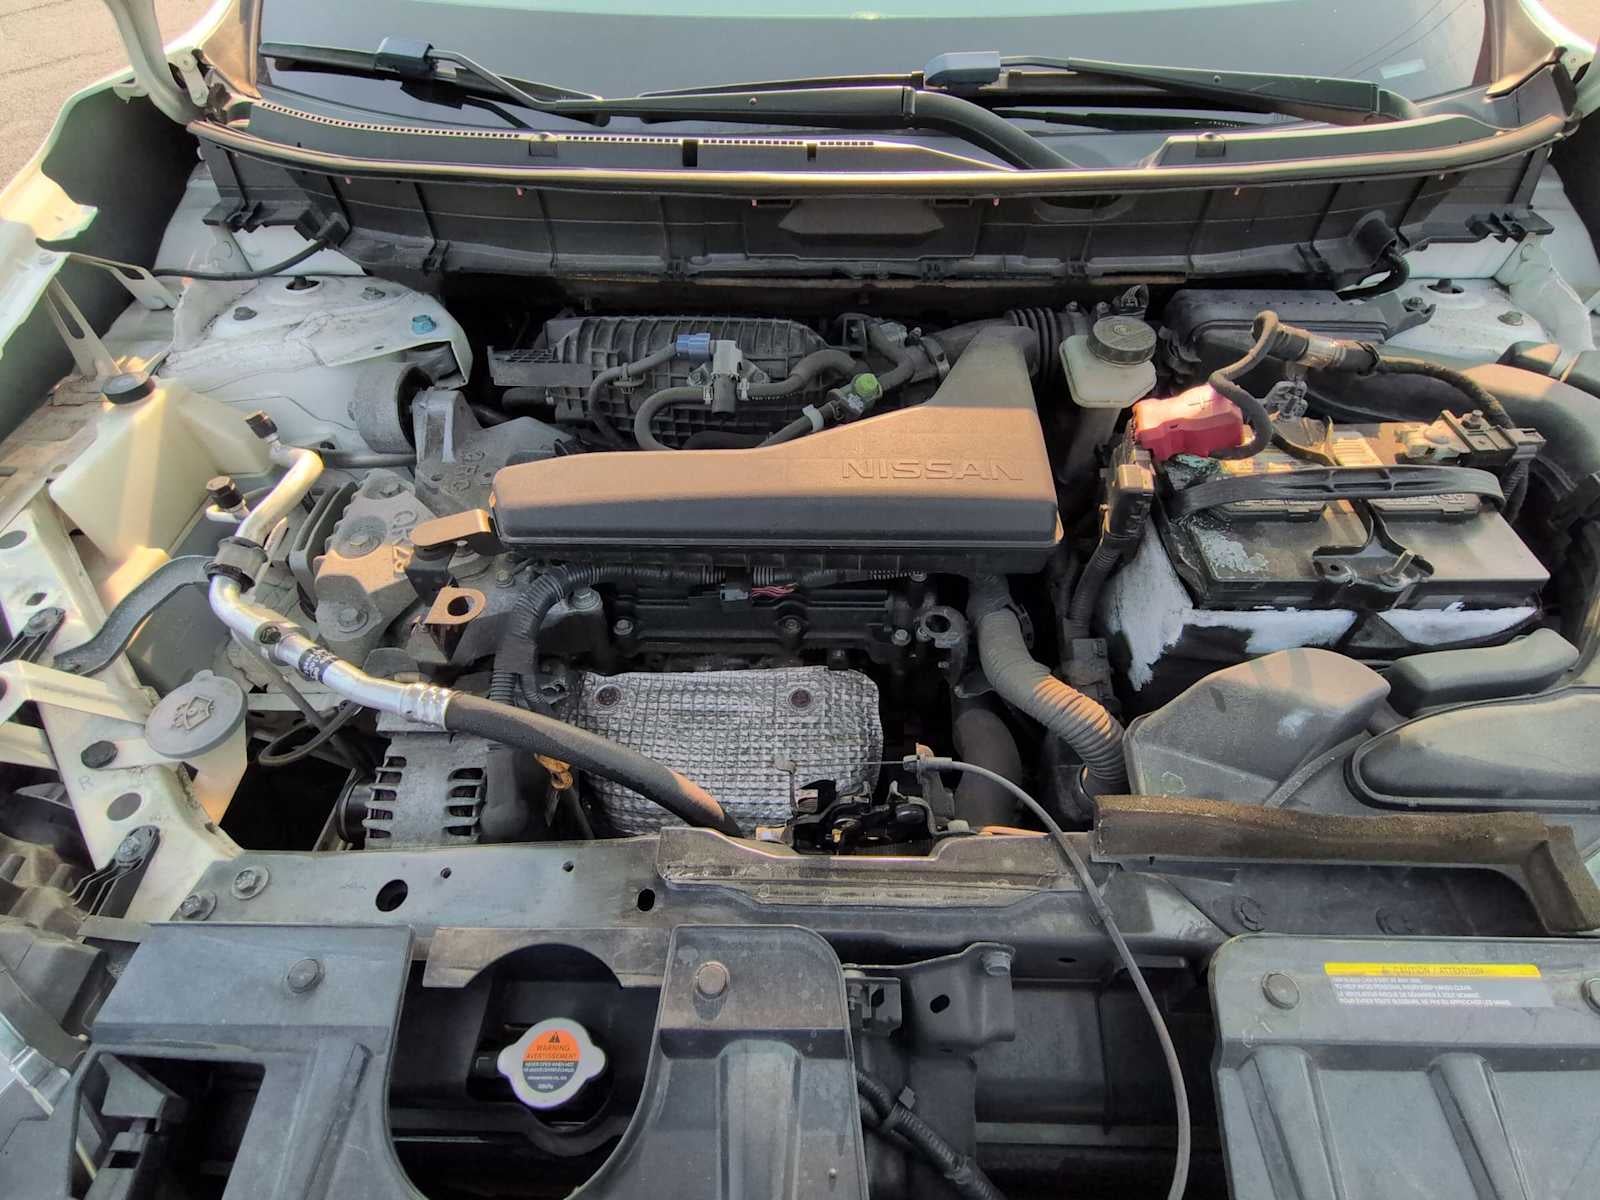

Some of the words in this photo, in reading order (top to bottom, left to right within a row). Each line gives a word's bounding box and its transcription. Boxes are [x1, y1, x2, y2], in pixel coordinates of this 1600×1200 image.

[842, 458, 1024, 481] NISSAN
[1393, 966, 1430, 974] CAUTION
[536, 1044, 570, 1052] WARNING
